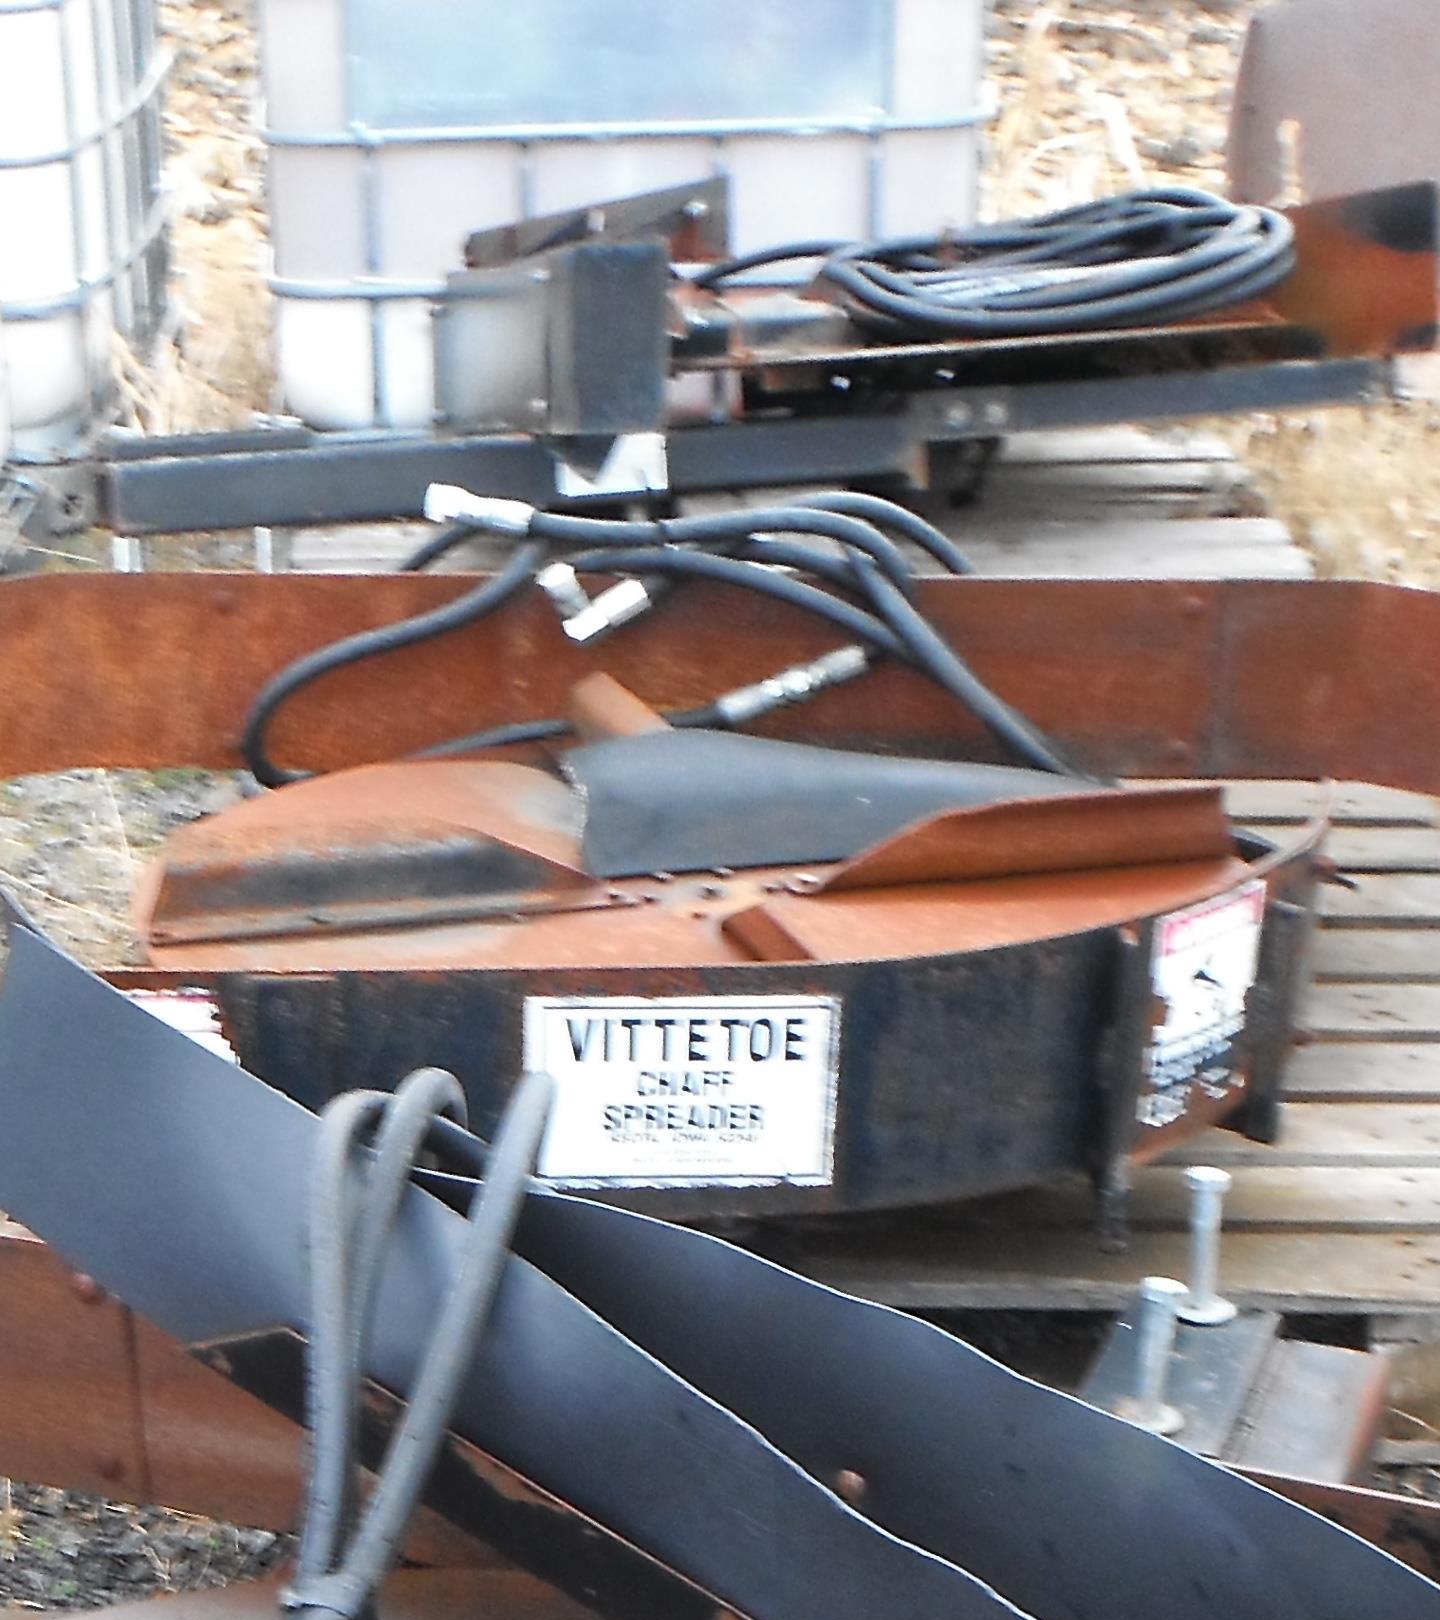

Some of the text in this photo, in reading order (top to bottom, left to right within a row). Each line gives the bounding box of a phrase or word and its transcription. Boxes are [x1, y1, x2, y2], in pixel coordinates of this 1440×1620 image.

[566, 1018, 806, 1062] VITTETOE
[637, 1071, 735, 1096] CHAFF
[603, 1105, 765, 1130] SPREADER
